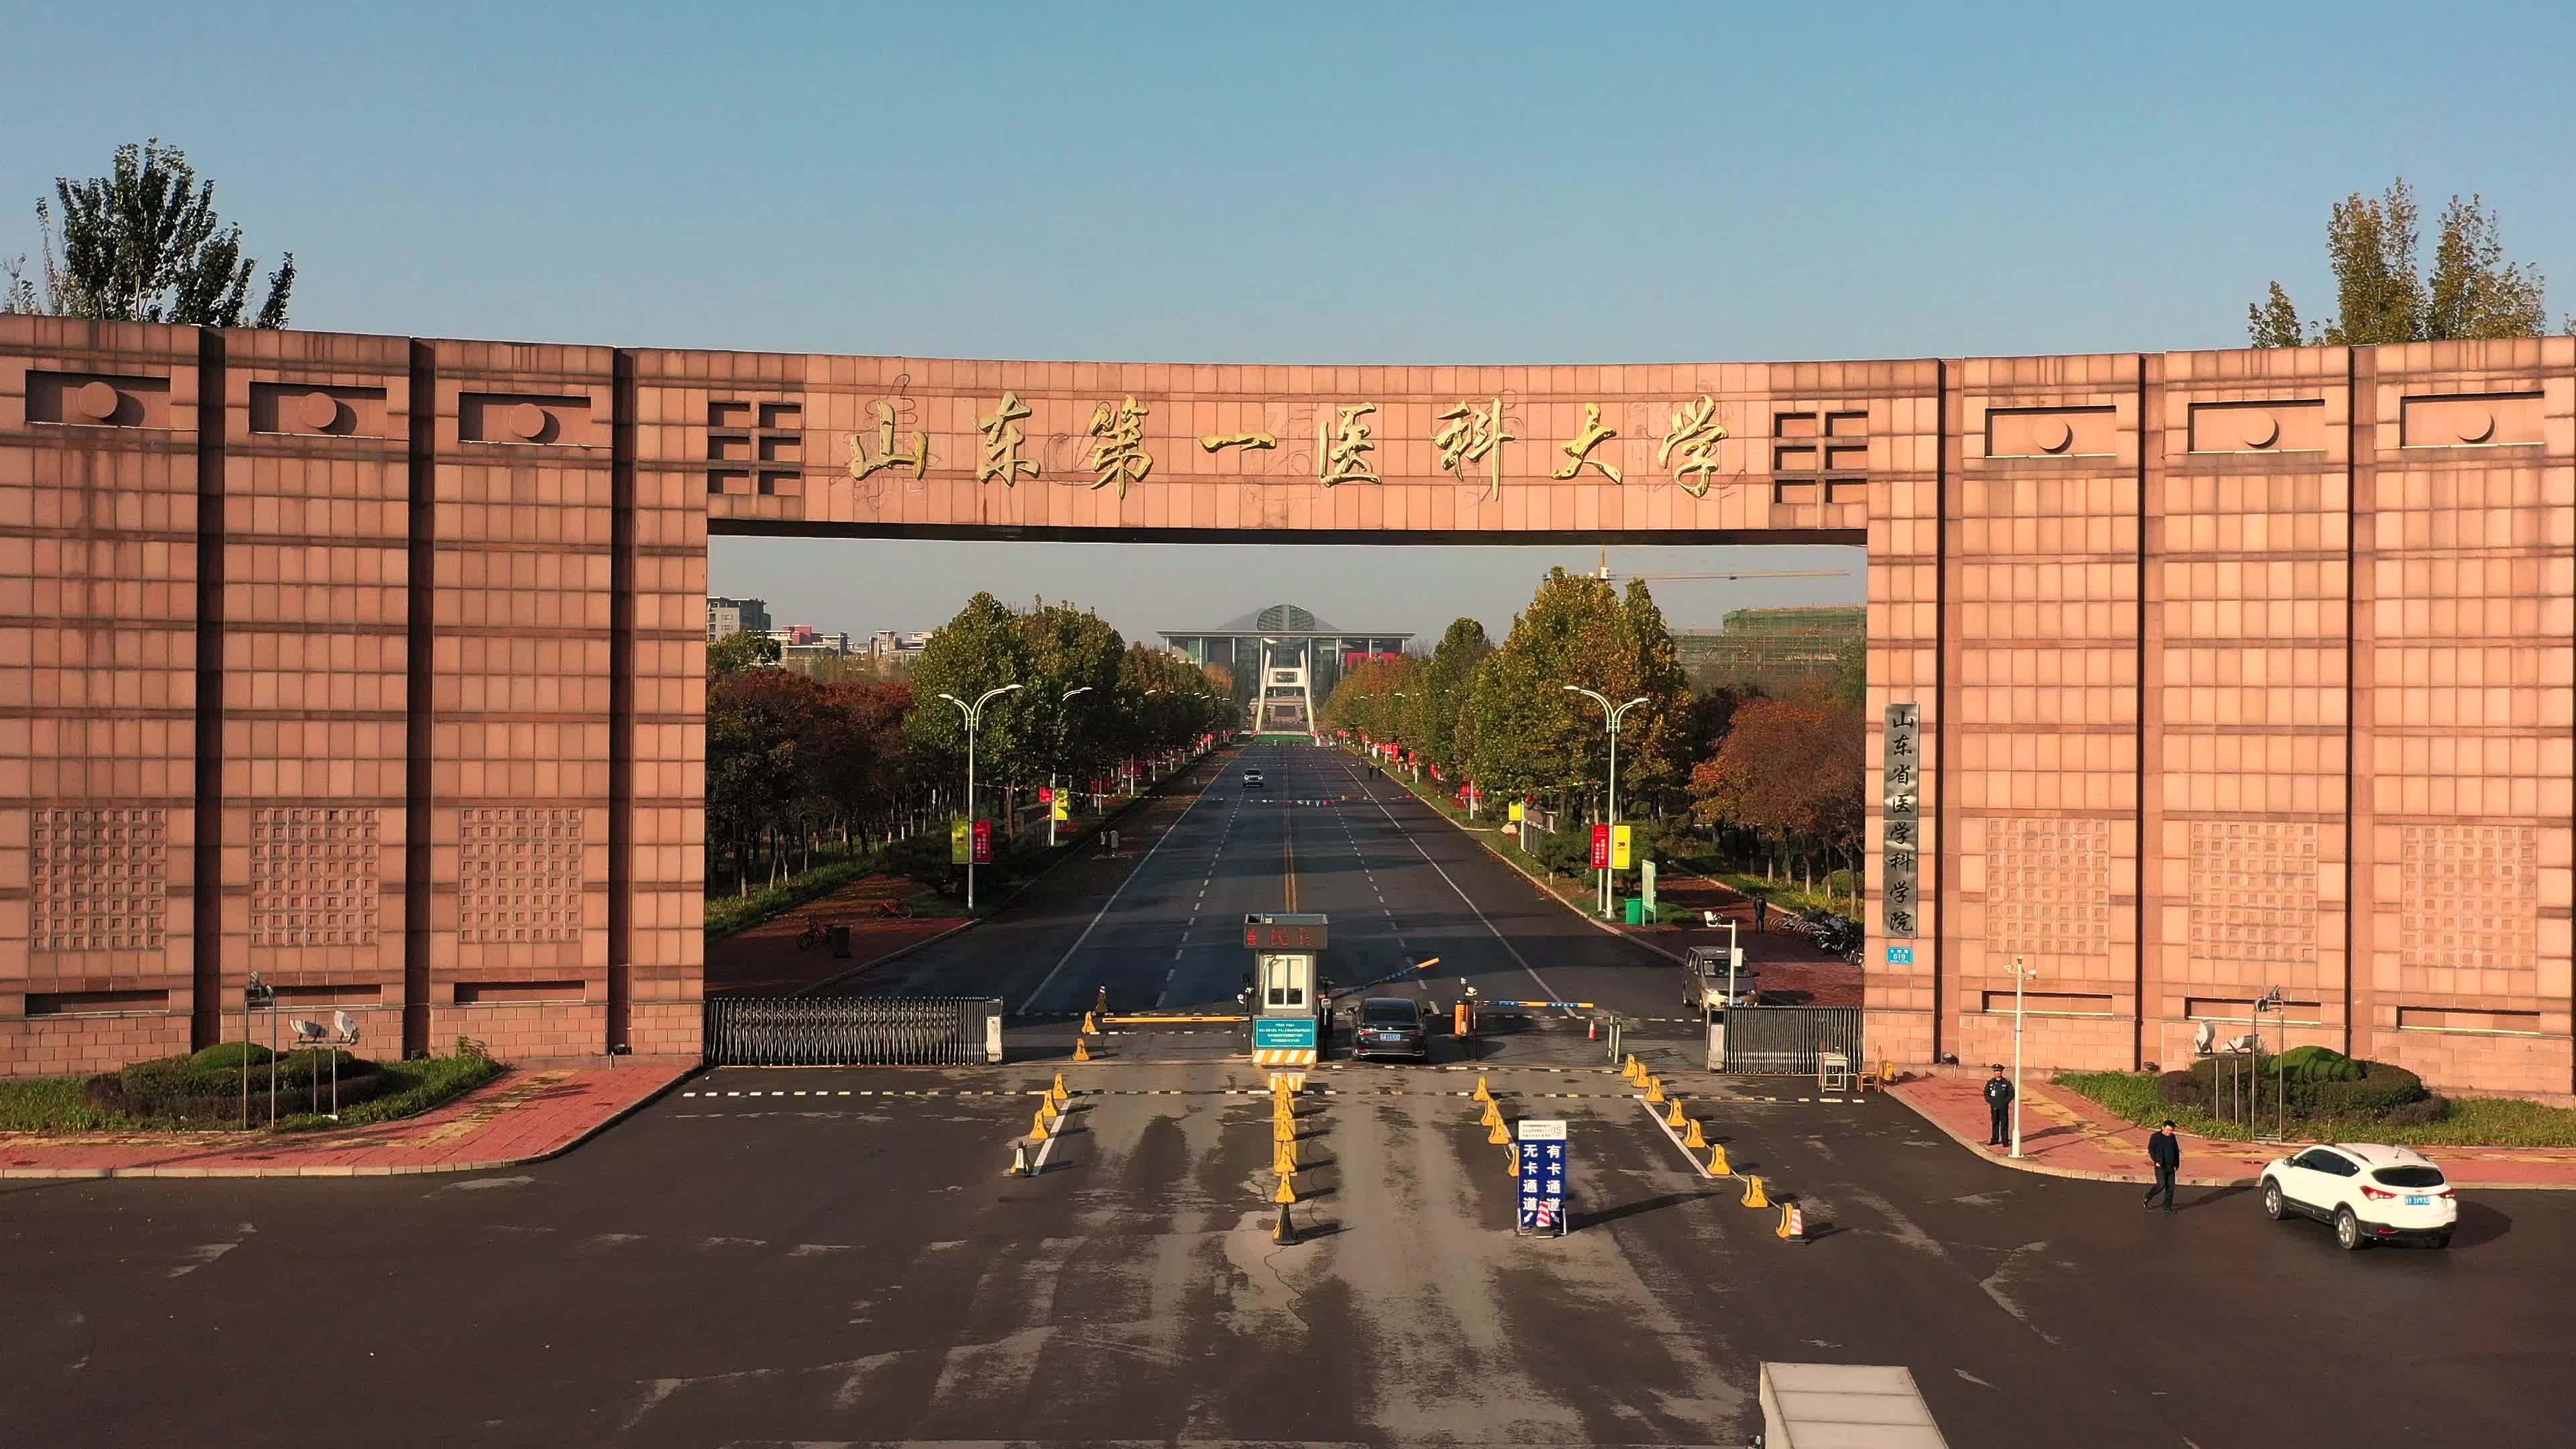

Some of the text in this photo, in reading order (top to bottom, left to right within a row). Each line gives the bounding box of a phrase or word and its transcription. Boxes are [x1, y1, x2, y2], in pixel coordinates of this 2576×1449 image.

[850, 390, 1729, 500] 山东第一医科大学
[1888, 709, 1915, 933] 山东省医学科学院
[1523, 1144, 1538, 1211] 无卡通道
[1546, 1144, 1562, 1212] 有卡通道
